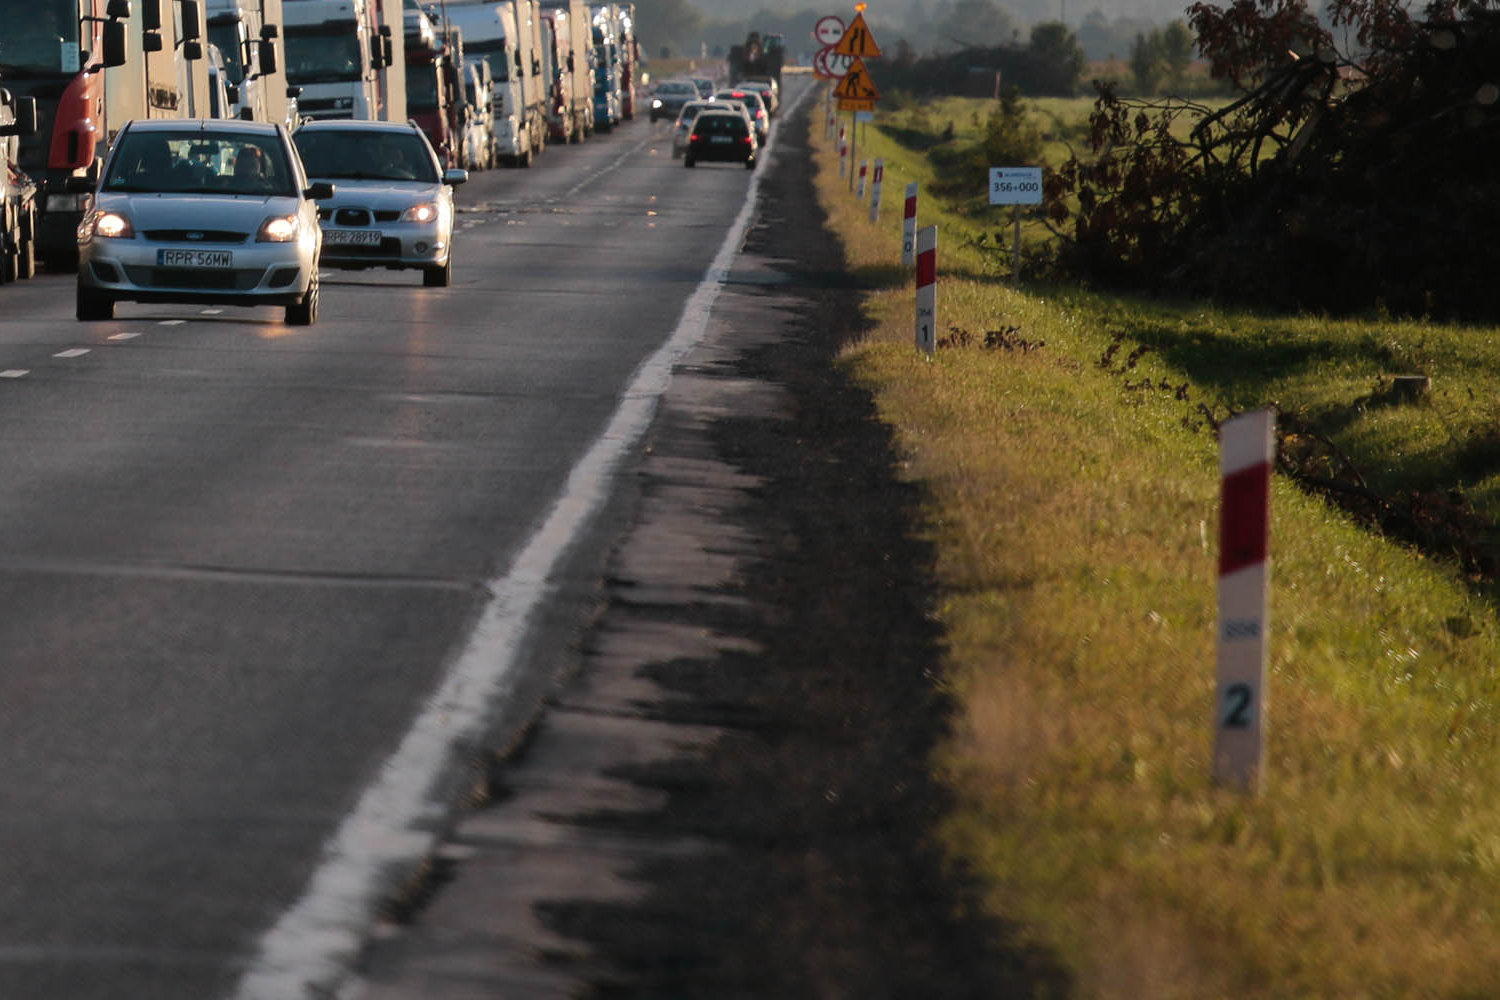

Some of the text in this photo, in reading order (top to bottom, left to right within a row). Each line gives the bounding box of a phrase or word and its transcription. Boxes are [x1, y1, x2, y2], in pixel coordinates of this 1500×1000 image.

[830, 52, 853, 69] 70
[165, 251, 229, 266] RPR 56MW
[921, 324, 928, 342] 1
[1225, 683, 1251, 728] 2
